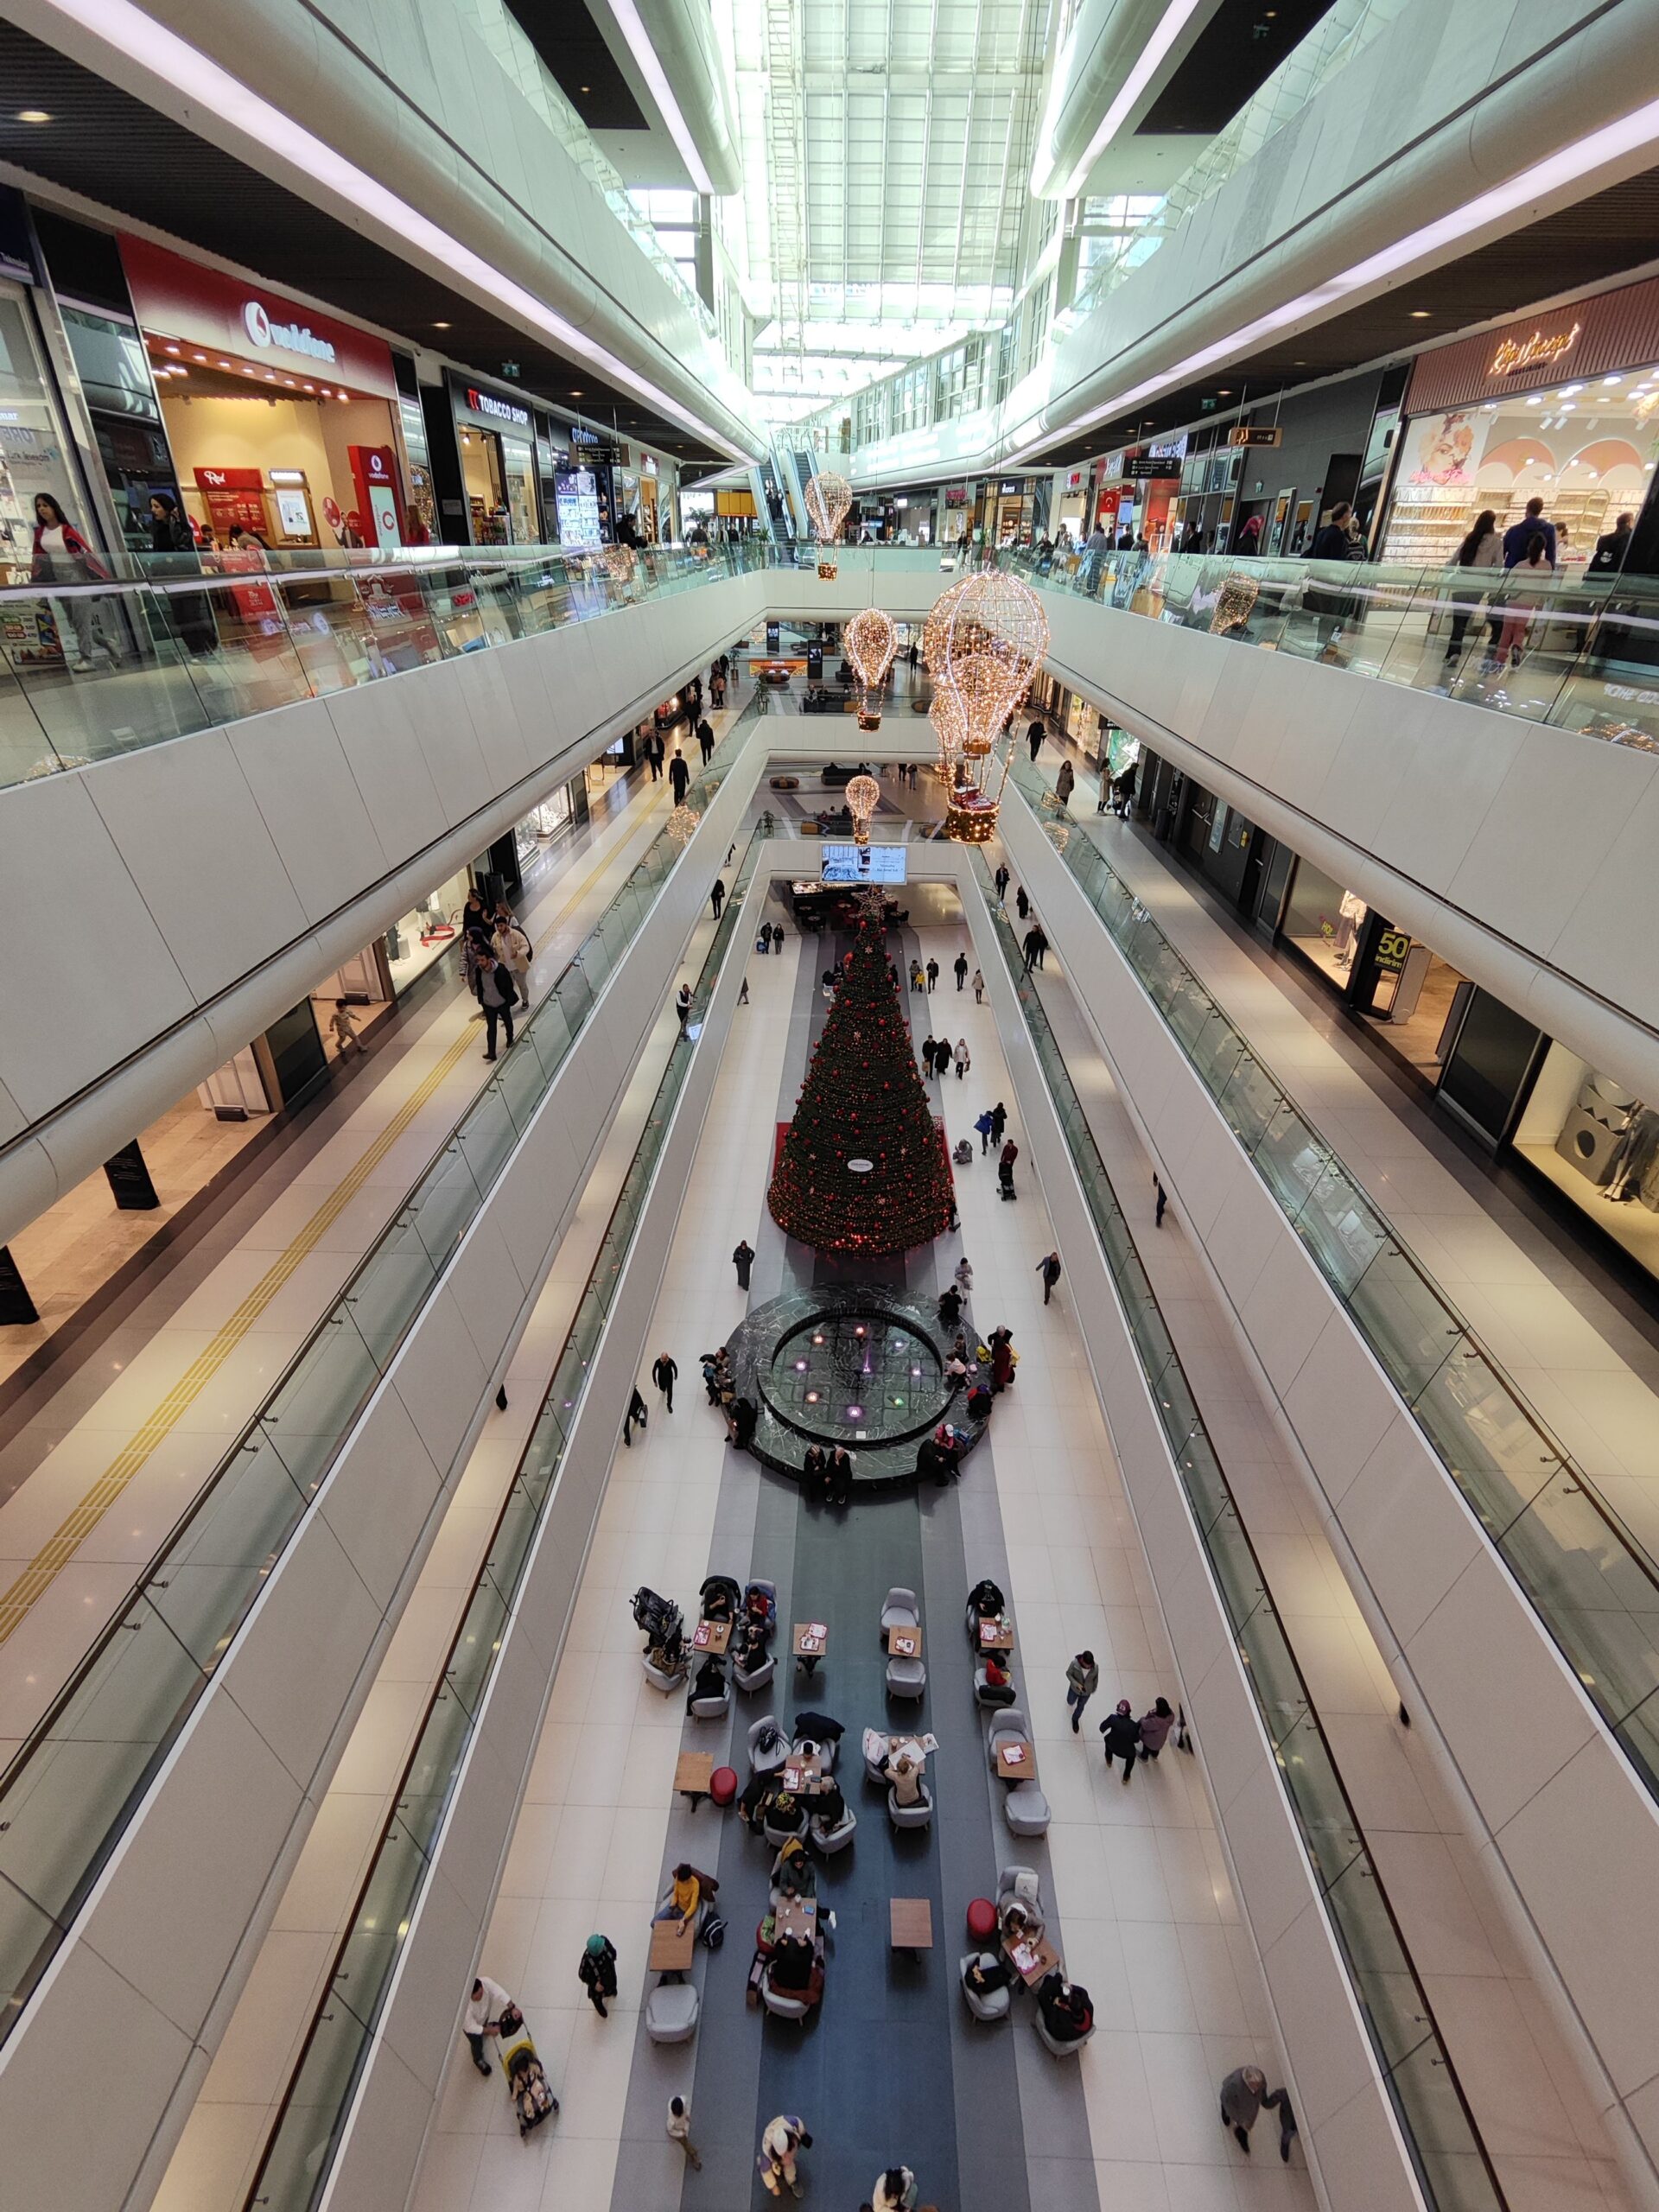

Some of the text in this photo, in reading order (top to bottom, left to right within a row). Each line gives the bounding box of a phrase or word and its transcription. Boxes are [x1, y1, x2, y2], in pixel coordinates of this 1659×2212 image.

[269, 323, 335, 363] vodafone
[479, 394, 512, 420] TOBACCO
[512, 406, 528, 425] SHOP
[1378, 932, 1408, 959] 50
